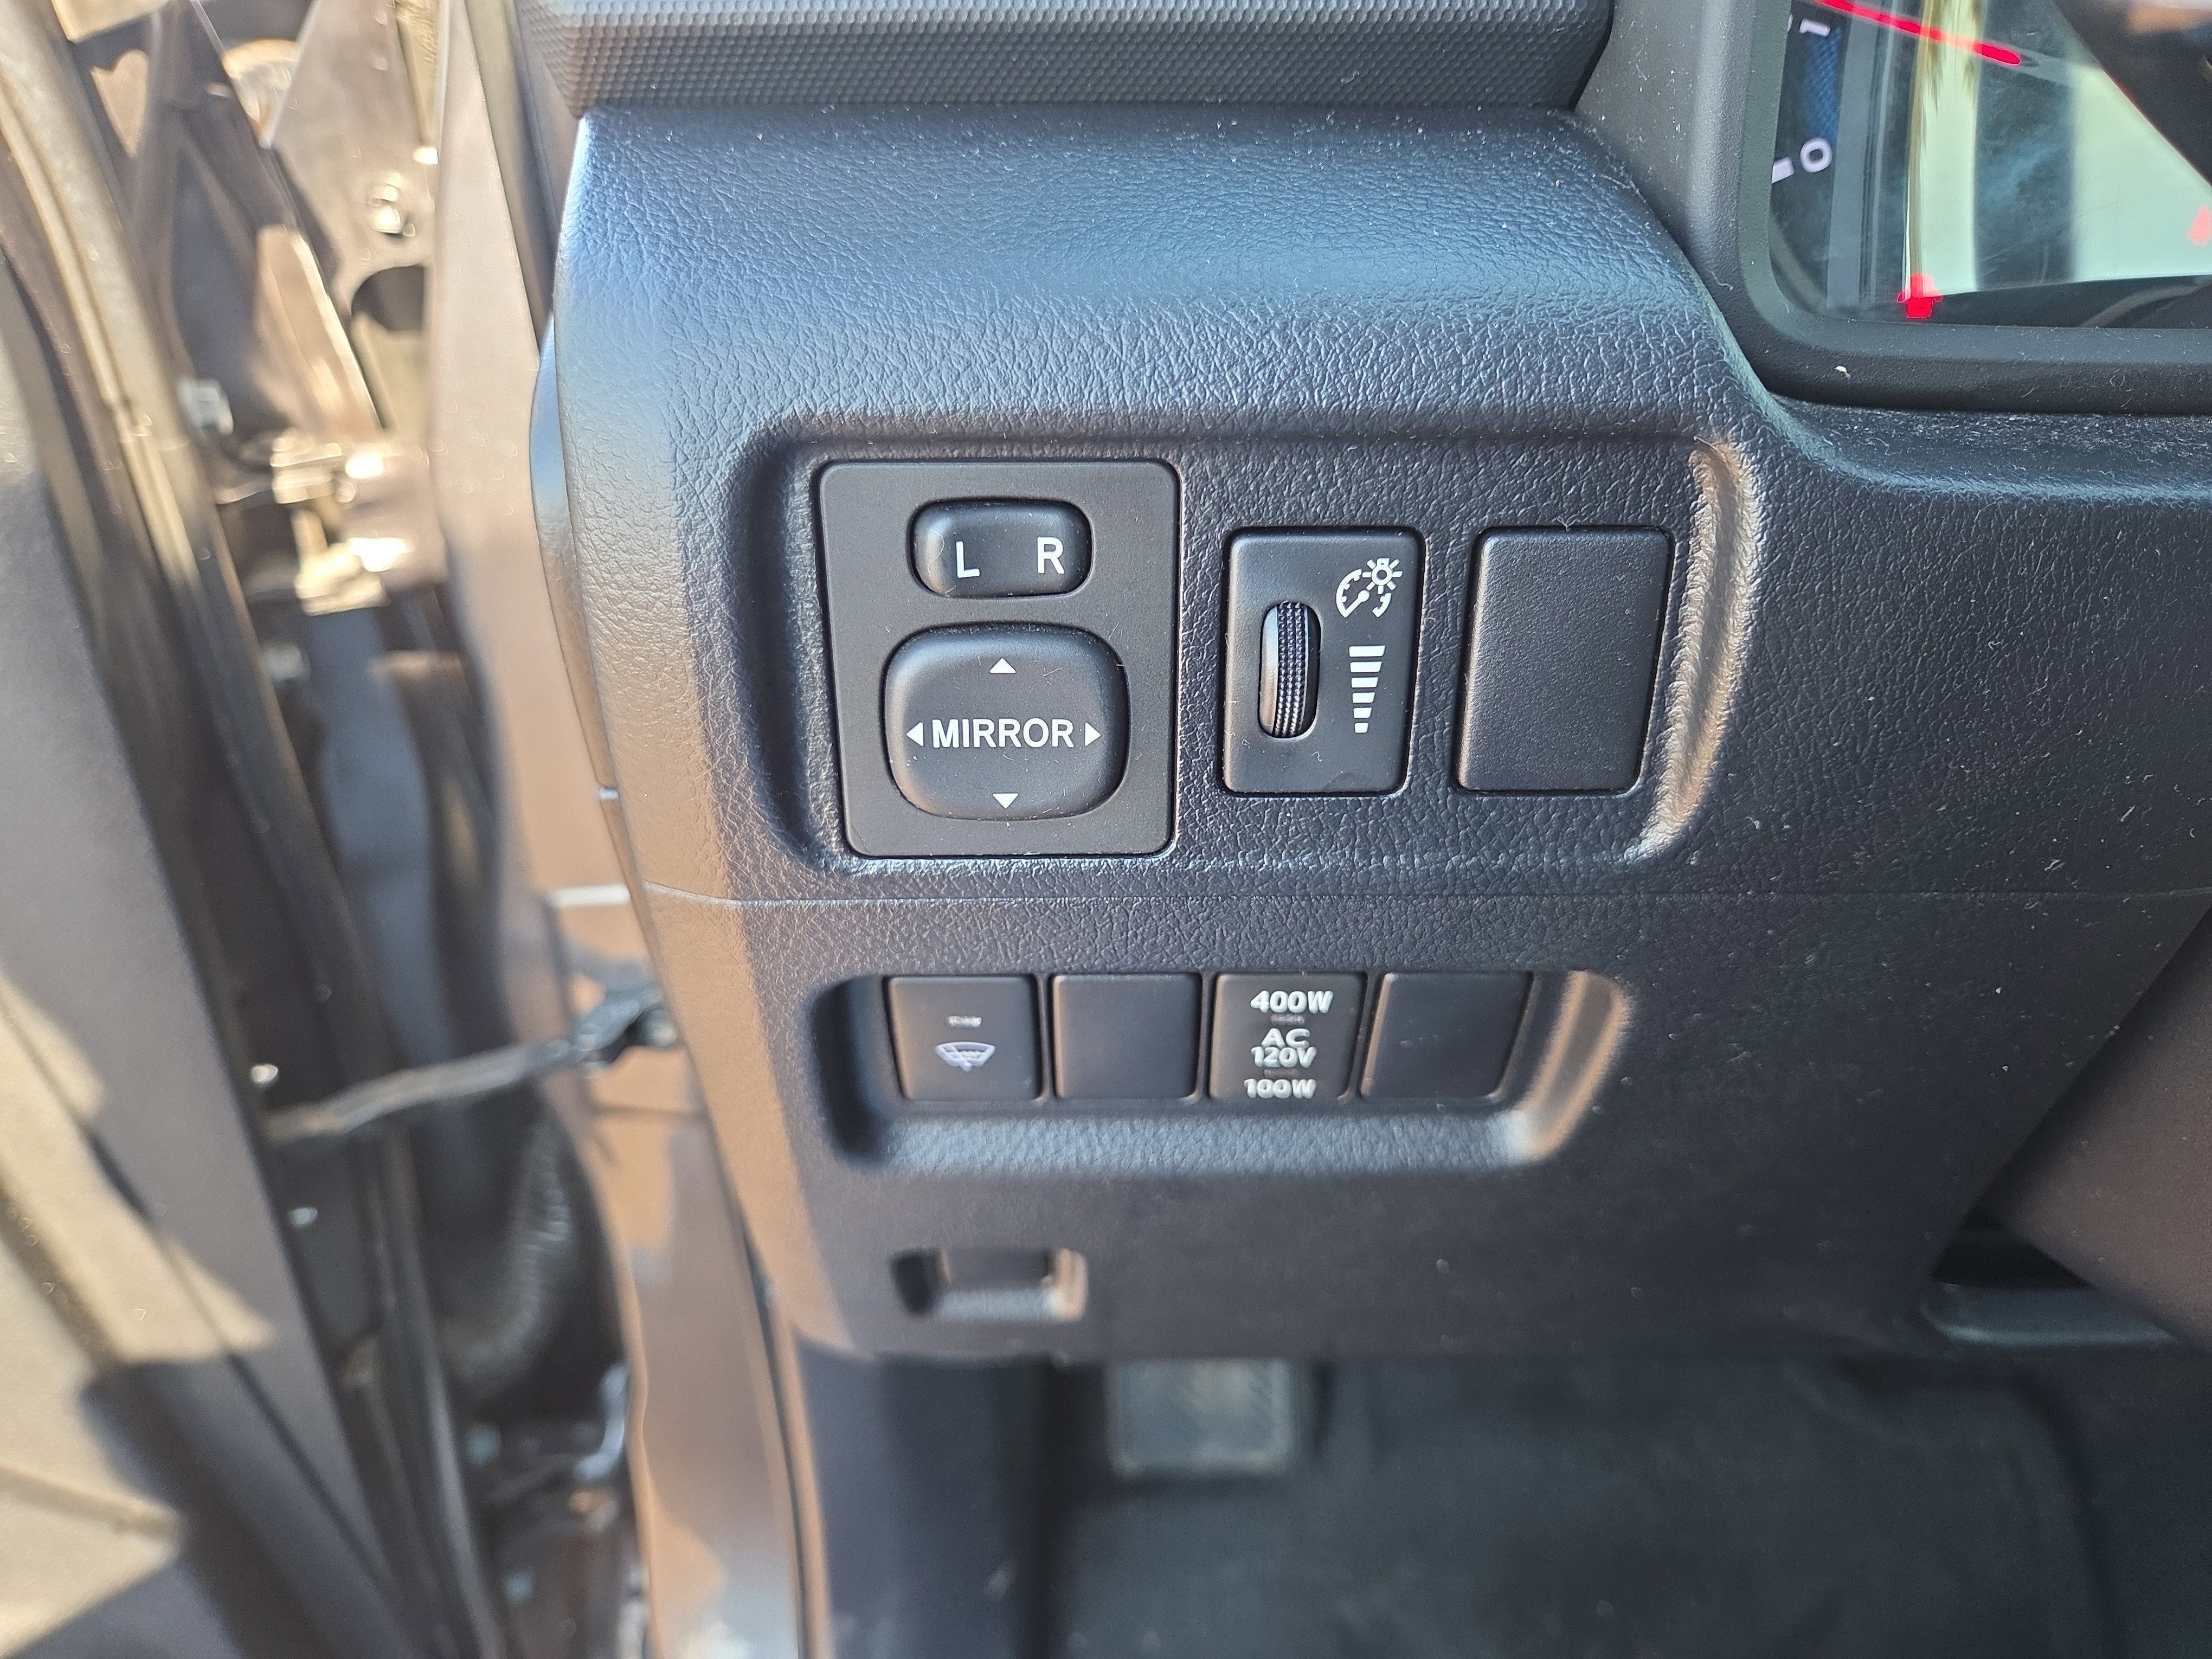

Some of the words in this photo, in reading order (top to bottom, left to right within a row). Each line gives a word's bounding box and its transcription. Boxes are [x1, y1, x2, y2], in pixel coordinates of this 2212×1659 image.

[956, 541, 980, 578] L
[1037, 536, 1065, 574] R
[931, 718, 1075, 748] MIRROR
[1250, 990, 1334, 1014] 400W
[1261, 1027, 1311, 1049] AC
[1250, 1046, 1317, 1068] 120V
[1243, 1078, 1317, 1099] 100W
